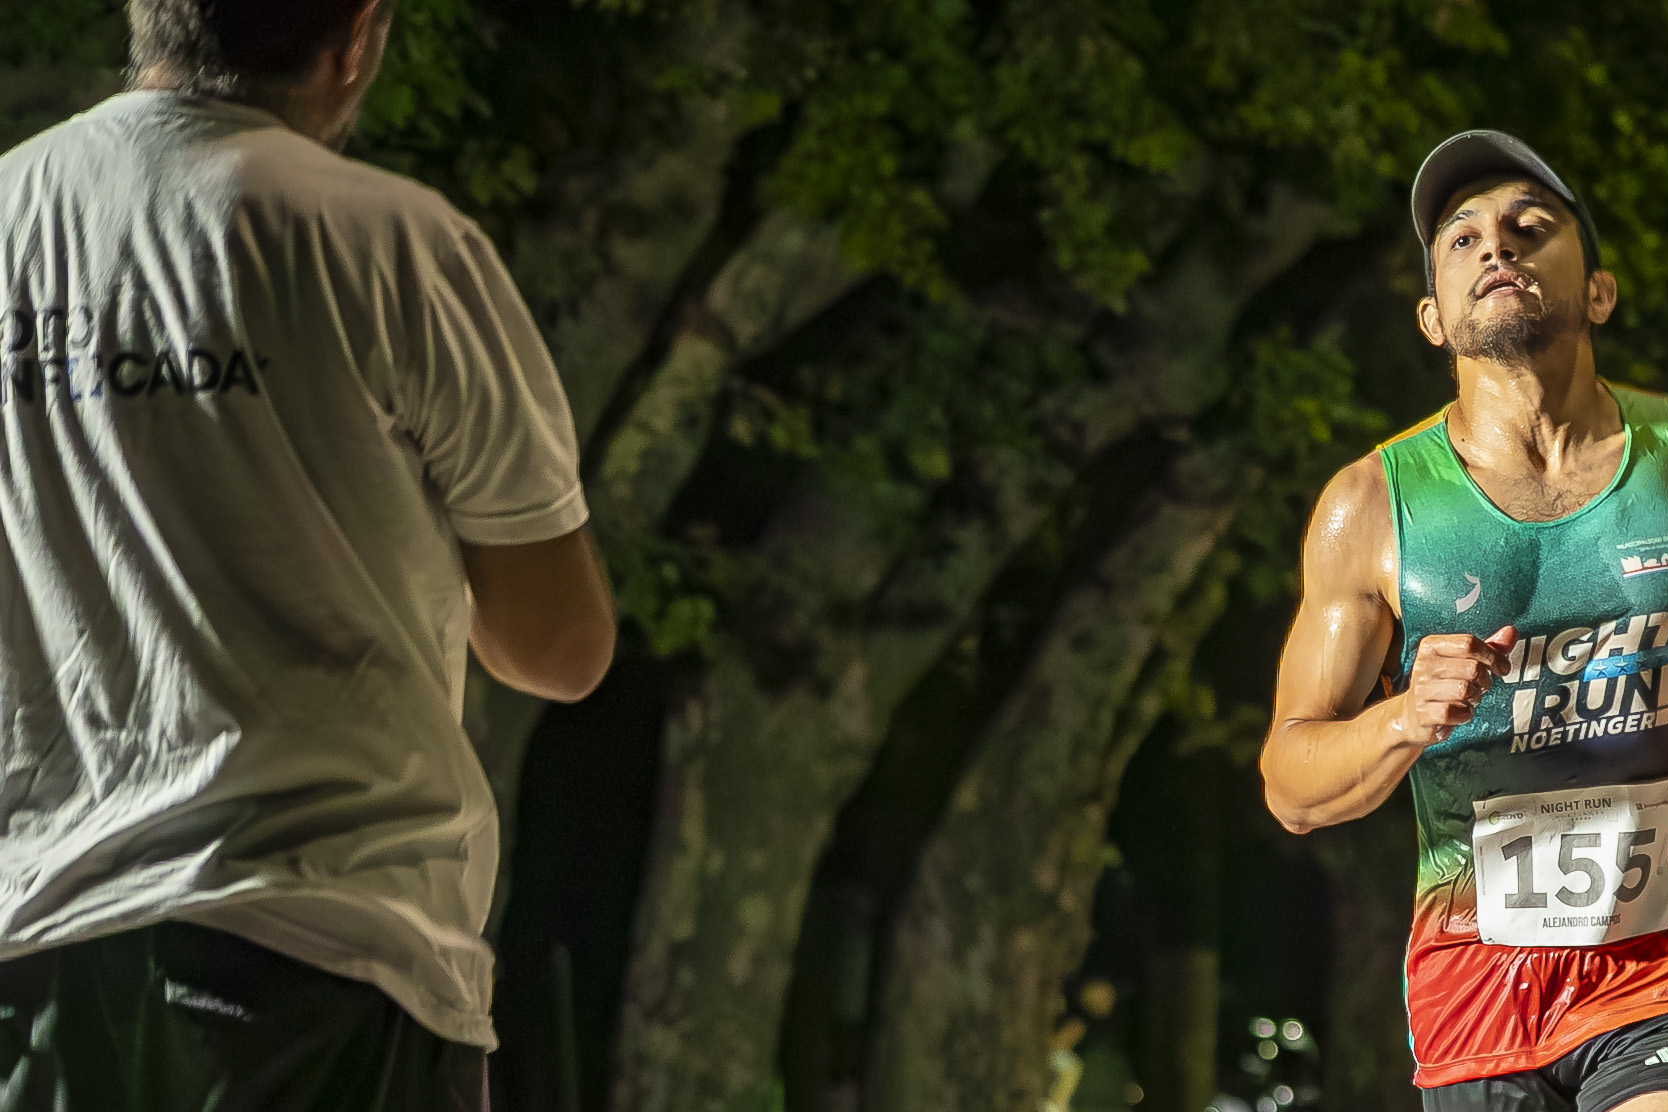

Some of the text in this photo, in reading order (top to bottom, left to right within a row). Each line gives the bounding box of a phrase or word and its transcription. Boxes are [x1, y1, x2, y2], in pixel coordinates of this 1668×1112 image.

[1510, 711, 1658, 754] NOETINGER
[1540, 801, 1581, 815] NIGHT
[1584, 796, 1612, 810] RUN
[1500, 828, 1657, 909] 155
[1542, 915, 1589, 929] ALEJANDRO
